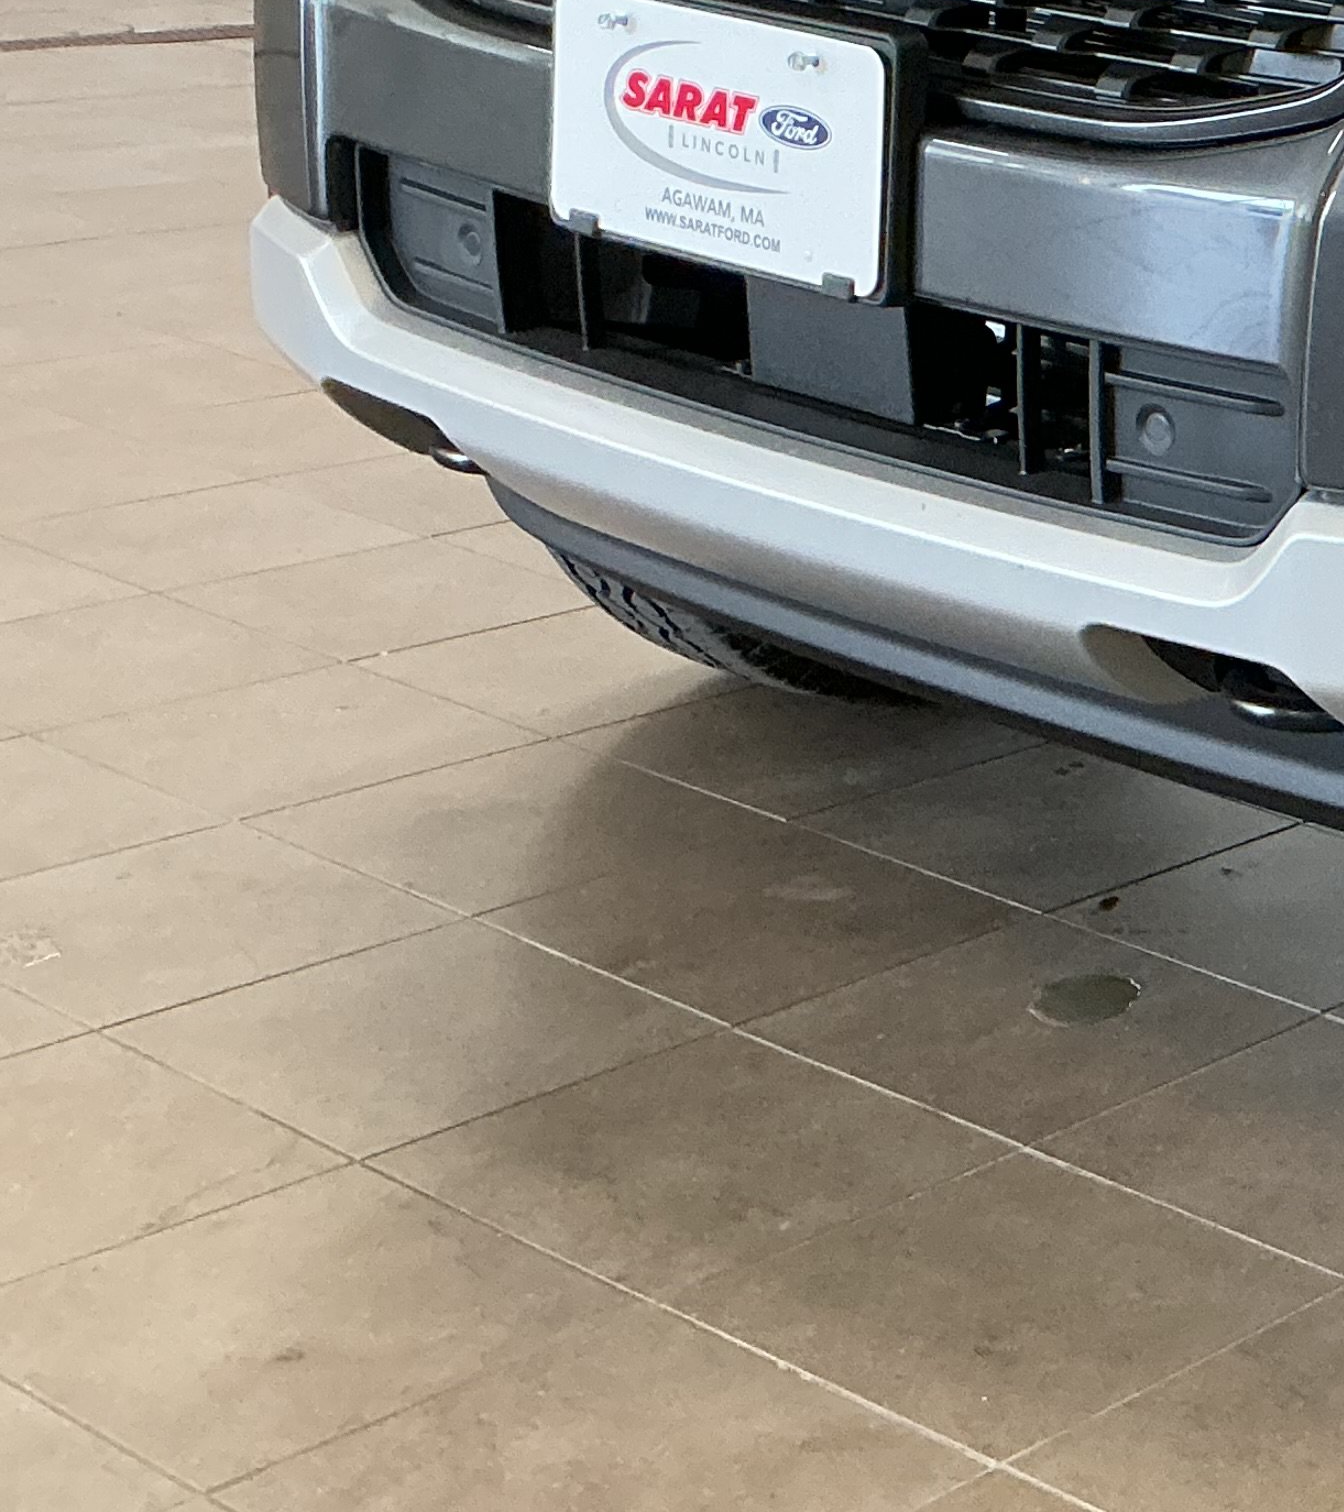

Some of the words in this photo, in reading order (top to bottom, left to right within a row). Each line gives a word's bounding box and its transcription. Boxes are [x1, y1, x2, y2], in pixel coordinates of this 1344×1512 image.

[620, 69, 759, 136] SARAT
[770, 109, 822, 146] Ford
[681, 131, 766, 165] LINCOLN
[661, 187, 736, 222] AGAWAM,
[740, 205, 765, 227] MA
[644, 207, 781, 253] WWW.SARATFORD.COM
